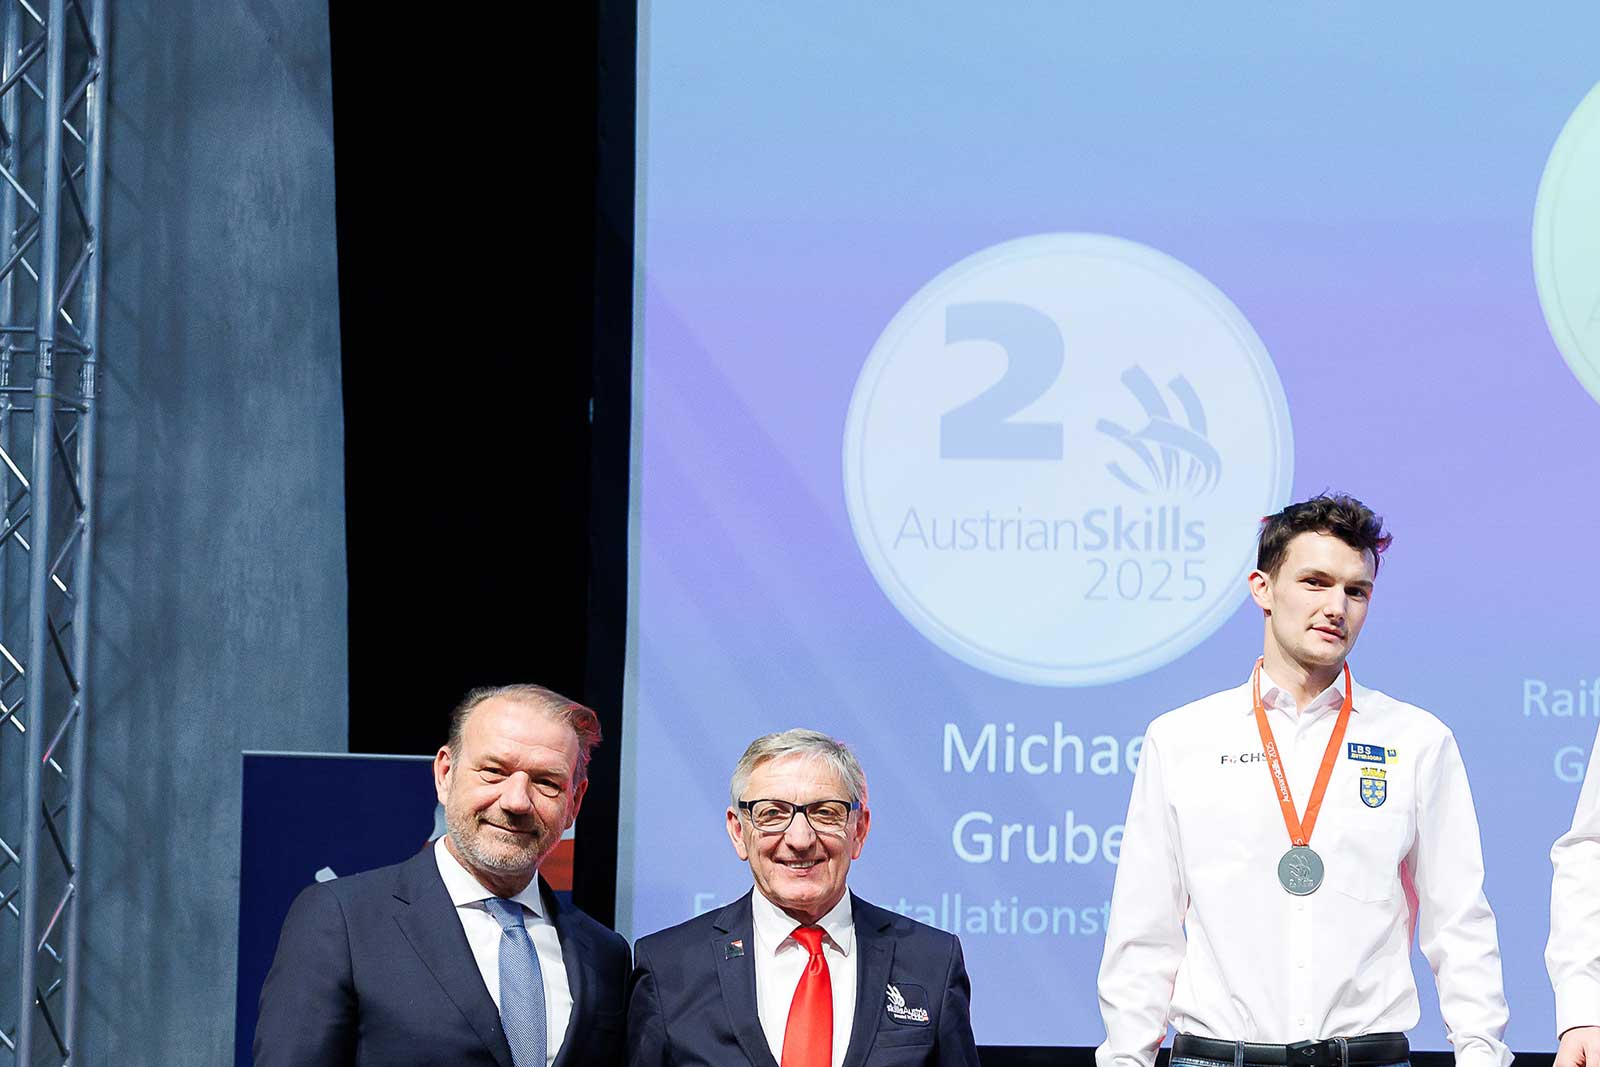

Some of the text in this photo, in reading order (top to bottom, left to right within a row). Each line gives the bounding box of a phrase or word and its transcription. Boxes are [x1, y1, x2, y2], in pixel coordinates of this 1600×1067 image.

[939, 300, 1066, 461] 2
[894, 505, 1206, 551] AustrianSkills
[1084, 558, 1206, 601] 2025
[1350, 744, 1372, 755] LBS
